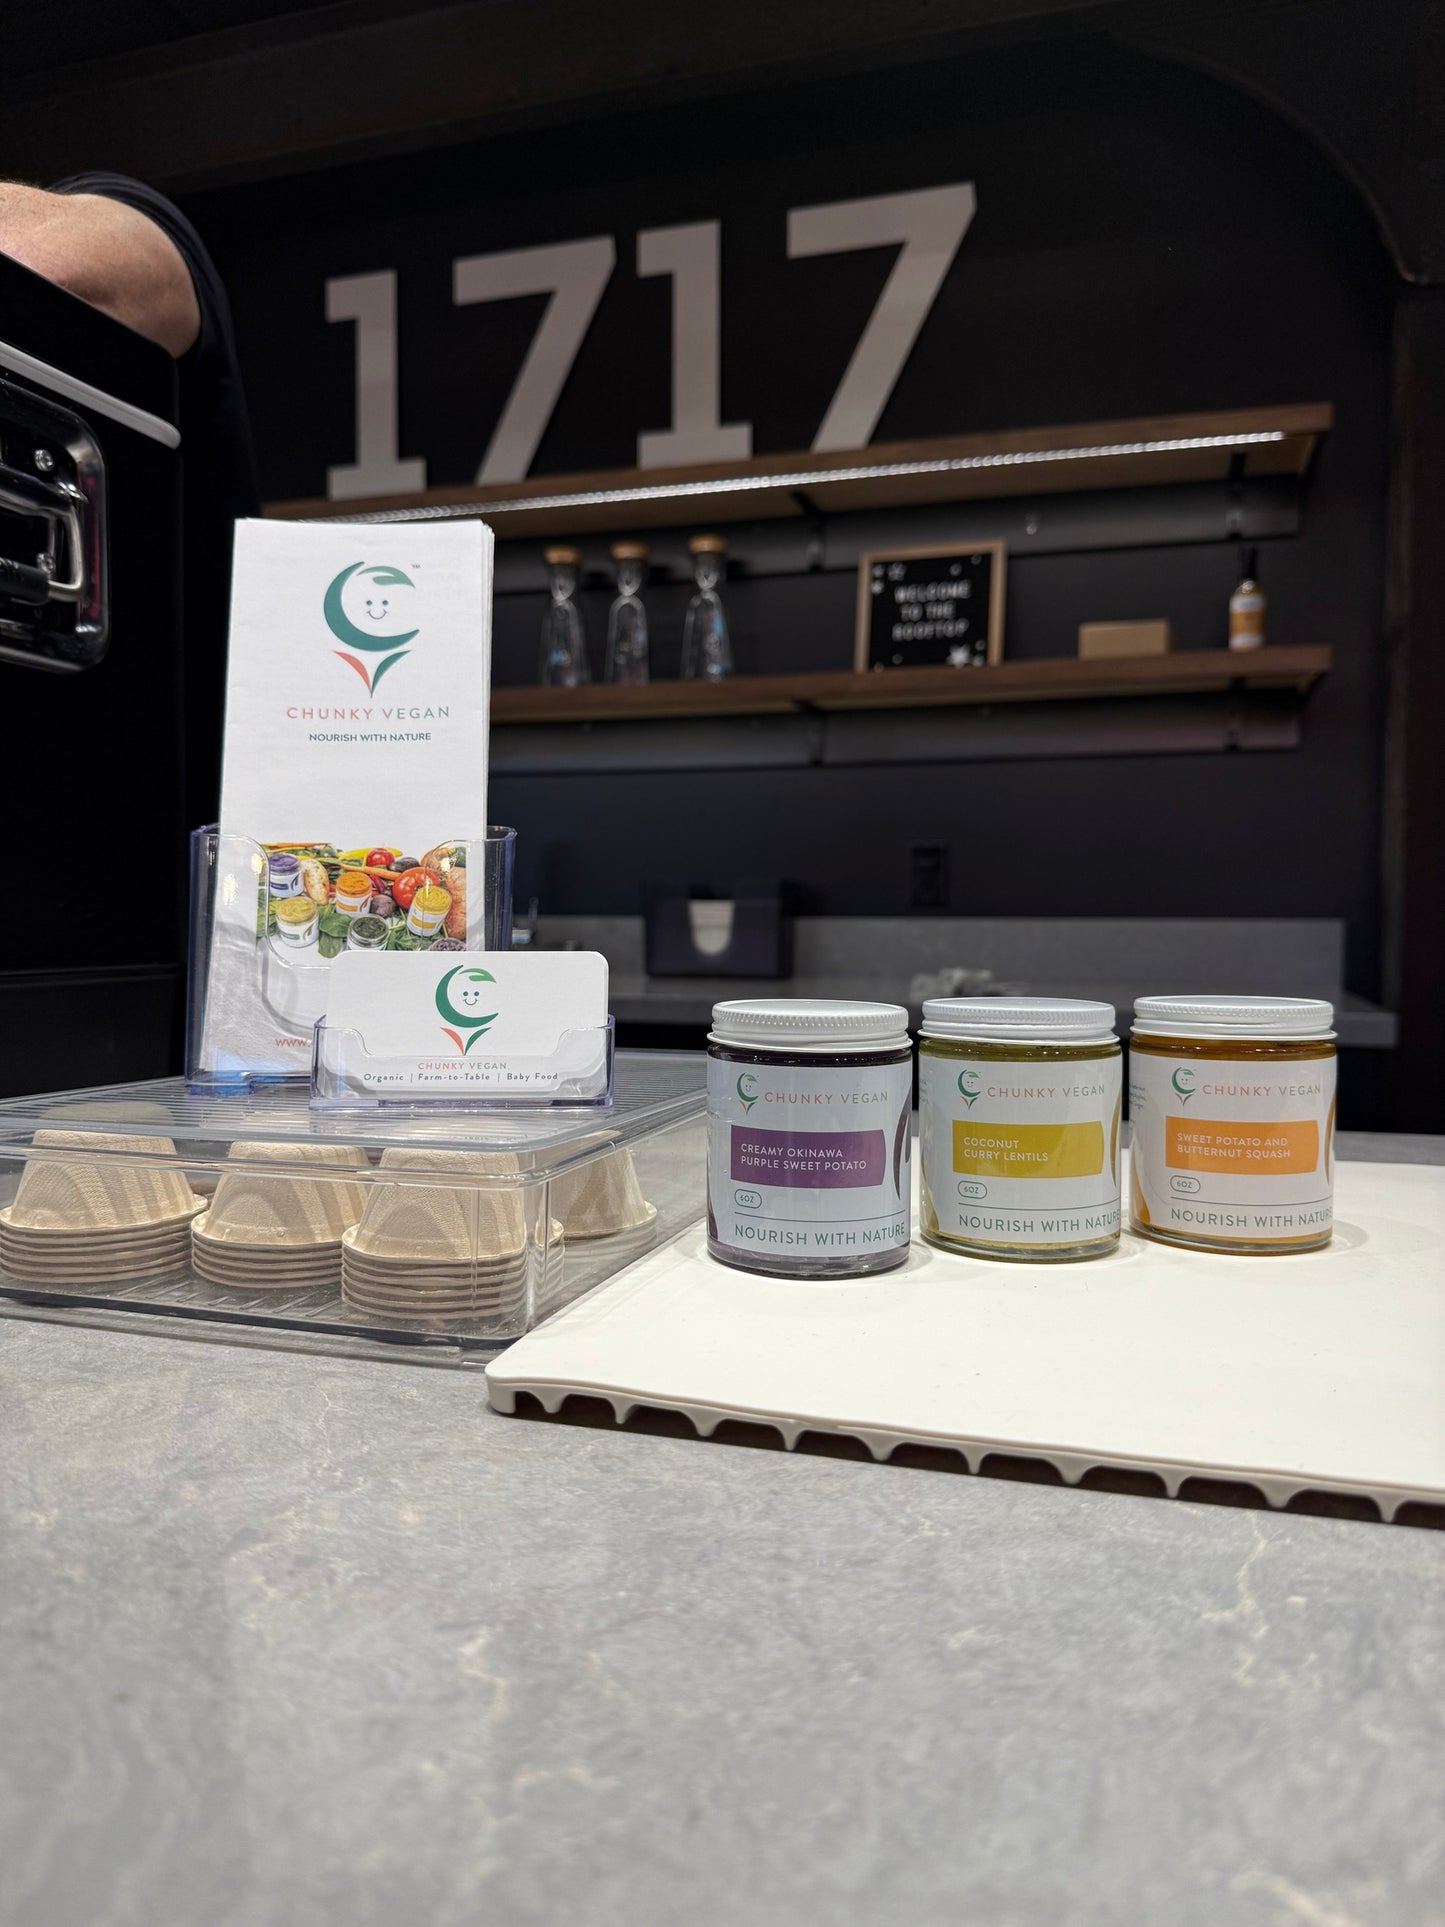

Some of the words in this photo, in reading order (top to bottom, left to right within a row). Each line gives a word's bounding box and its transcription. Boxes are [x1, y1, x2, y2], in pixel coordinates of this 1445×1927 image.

[325, 181, 977, 499] 1717
[286, 707, 373, 720] CHUNKY
[382, 706, 450, 720] VEGAN
[309, 733, 358, 742] NOURISH
[360, 733, 387, 742] WITH
[389, 732, 432, 741] NATURE
[418, 1062, 464, 1070] CHUNKY
[363, 1073, 404, 1082] Organic
[418, 1073, 490, 1081] Farm-to-Table
[506, 1073, 530, 1081] Baby
[534, 1072, 558, 1080] Food
[987, 1087, 1055, 1098] CHUNKY
[1062, 1084, 1105, 1097] VEGAN
[1202, 1084, 1272, 1097] CHUNKY
[1278, 1083, 1321, 1096] VEGAN
[764, 1091, 833, 1105] CHUNKY
[841, 1091, 888, 1104] VEGAN
[963, 1136, 1019, 1149] COCONUT
[1176, 1132, 1212, 1144] SWEET
[1215, 1136, 1261, 1146] POTATO
[1264, 1137, 1288, 1146] AND
[741, 1143, 784, 1157] CREAMY
[787, 1148, 843, 1158] OKINAWA
[964, 1149, 1000, 1160] CURRY
[1003, 1152, 1048, 1161] LENTILS
[1177, 1145, 1242, 1157] BUTTERNUT
[1246, 1149, 1291, 1159] SQUASH
[741, 1155, 779, 1169] PURPLE
[783, 1161, 820, 1171] SWEET
[824, 1160, 867, 1171] POTATO
[959, 1214, 1034, 1232] NOURISH
[1041, 1219, 1080, 1232] WITH
[1171, 1207, 1247, 1227] NOURISH
[1254, 1215, 1293, 1227] WITH
[735, 1223, 807, 1245] NOURISH
[815, 1232, 856, 1245] WITH
[862, 1222, 905, 1242] NATURE
